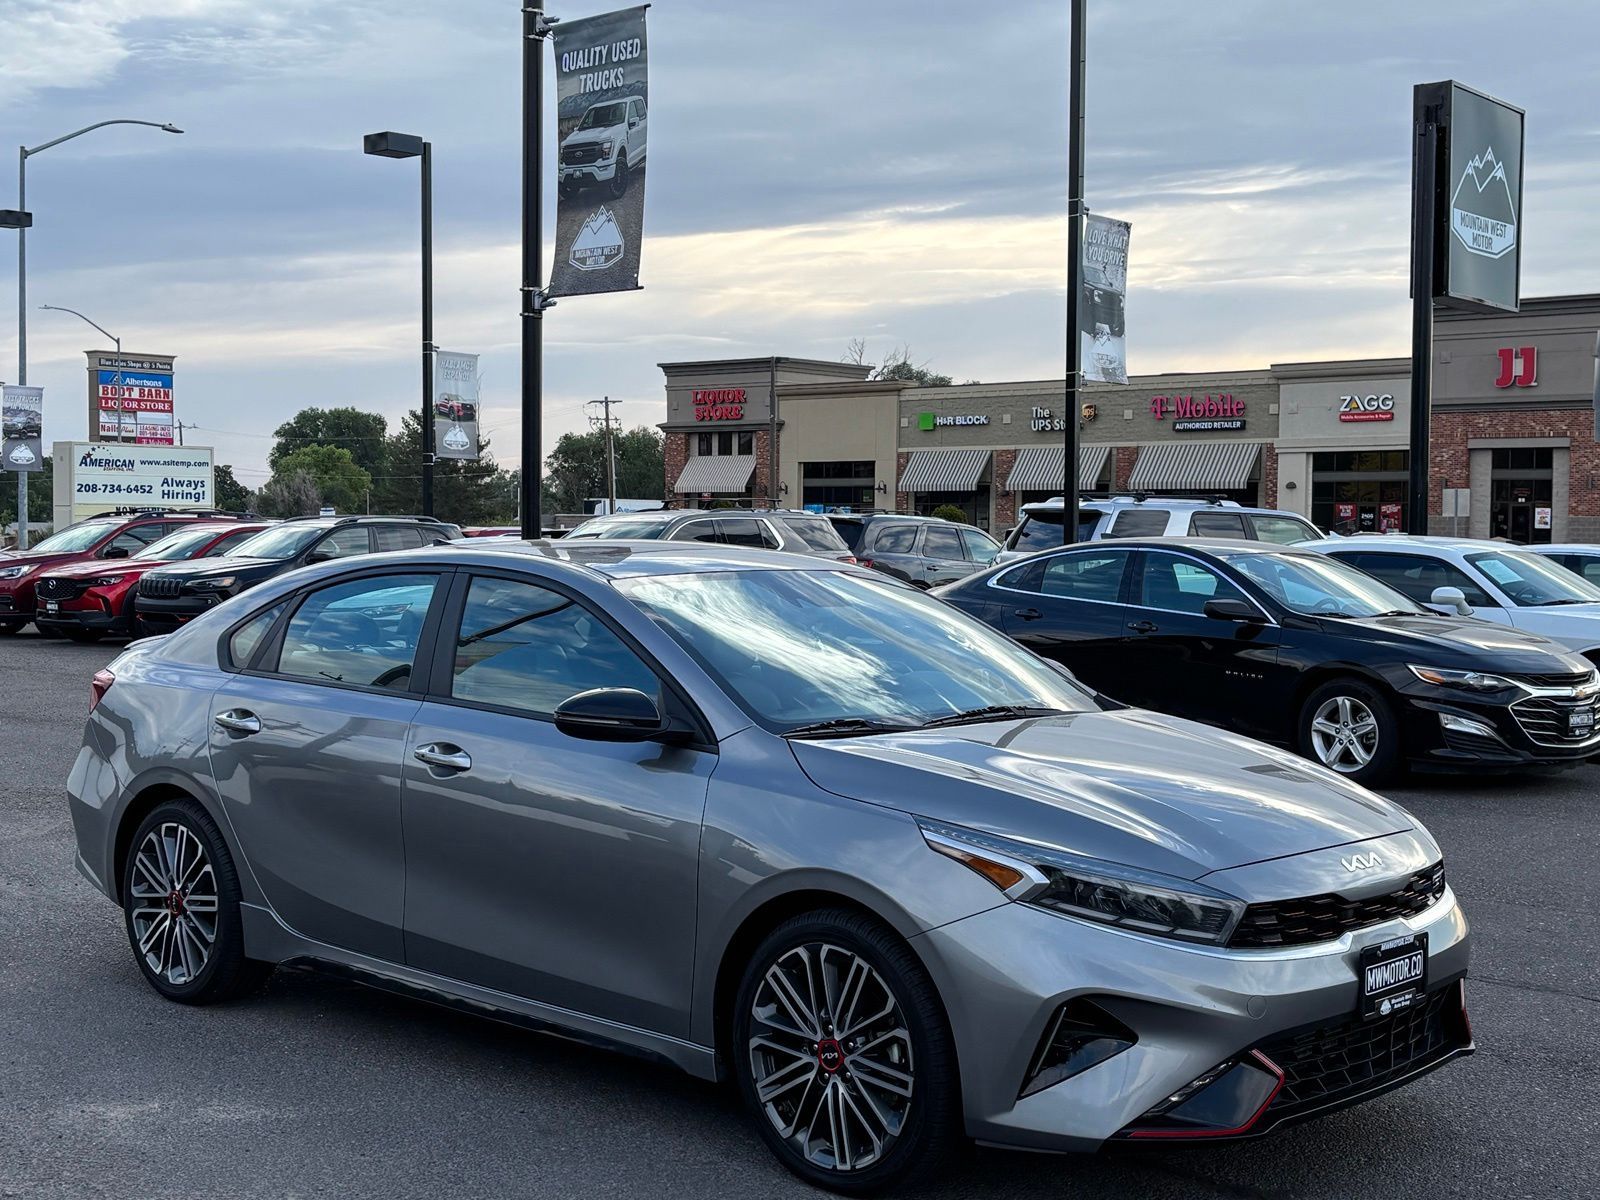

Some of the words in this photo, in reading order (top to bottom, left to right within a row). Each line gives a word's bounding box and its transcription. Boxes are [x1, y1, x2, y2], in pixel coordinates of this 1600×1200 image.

[562, 45, 609, 73] QUALITY
[612, 38, 641, 62] USED
[579, 67, 624, 94] TRUCKS
[1460, 211, 1490, 235] MOUNTAIN
[1490, 220, 1508, 239] WEST
[1088, 229, 1107, 245] LOVE
[1108, 233, 1128, 250] WHAT
[1472, 231, 1494, 251] MOTOR
[603, 245, 618, 256] WEST
[1088, 246, 1103, 263] YOU
[1103, 250, 1125, 266] DRIVE
[113, 359, 126, 367] Laes
[124, 377, 162, 387] Albertsons
[101, 385, 134, 398] BOOT
[138, 388, 170, 400] BARN
[691, 388, 747, 407] LIQUOR
[101, 399, 139, 409] LIQUOR
[140, 401, 171, 411] STORE
[1151, 393, 1246, 421] T-Mobile
[1340, 394, 1394, 412] ZAGG
[695, 405, 744, 422] STORE
[1031, 406, 1051, 418] The
[936, 416, 954, 426] H&R
[955, 415, 988, 425] BLOCK
[1031, 419, 1052, 432] UPS
[1175, 421, 1213, 430] AUTHORIZED
[1213, 421, 1242, 429] RETAILER
[79, 455, 136, 469] AMERICAN
[139, 459, 210, 468] www.asitemp.com
[76, 483, 154, 495] 208-734-6452
[161, 477, 206, 490] Always
[161, 489, 206, 502] Hiring!
[1367, 953, 1423, 993] MWMOTOR.CO
